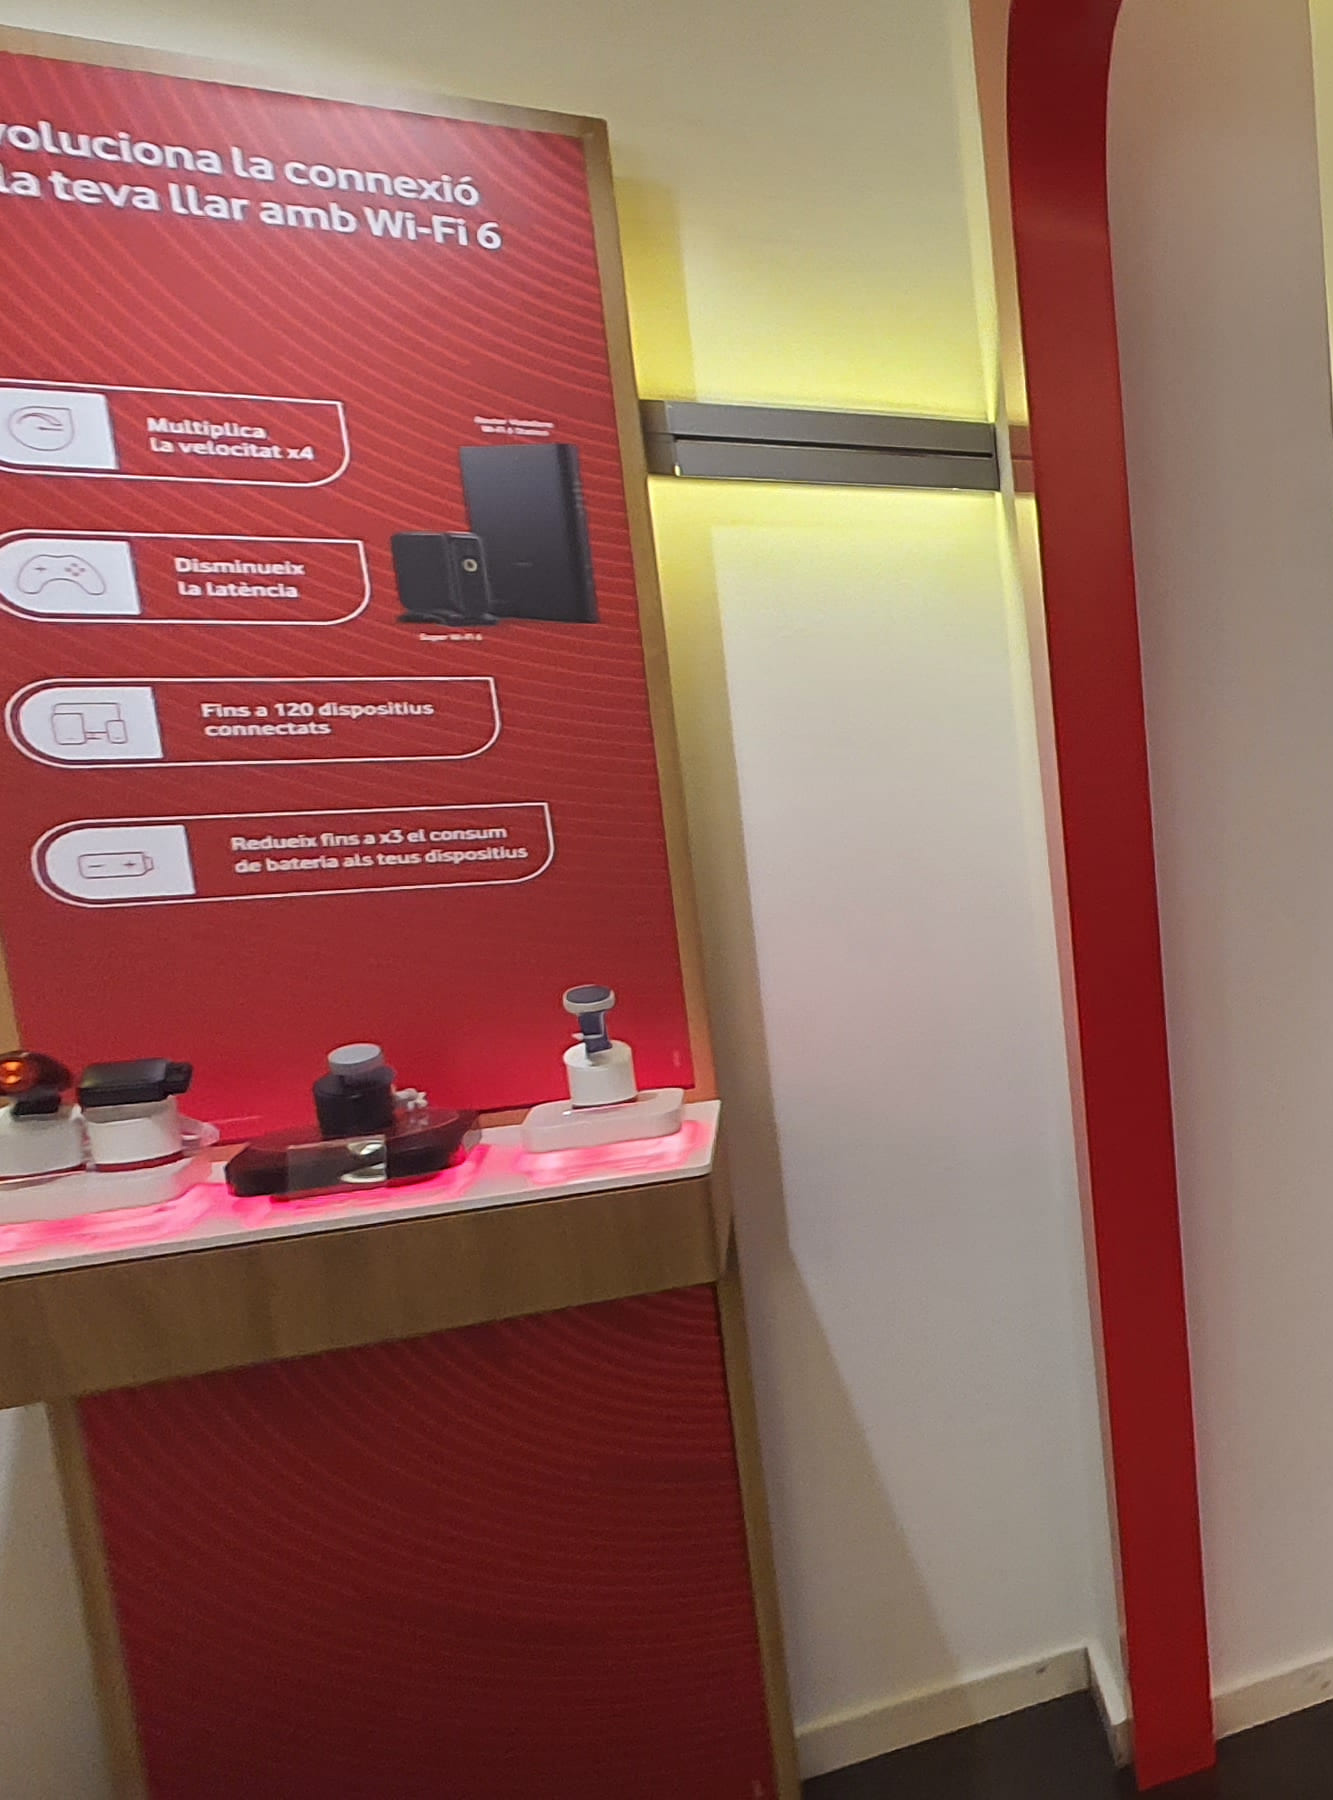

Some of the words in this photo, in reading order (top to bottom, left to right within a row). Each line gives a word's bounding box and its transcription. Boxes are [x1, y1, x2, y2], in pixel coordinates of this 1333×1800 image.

[0, 120, 223, 175] oluciona
[231, 146, 276, 182] la
[283, 160, 481, 207] connexió
[48, 169, 161, 212] teva
[168, 182, 250, 221] llar
[259, 200, 358, 234] amb
[362, 205, 470, 246] Wi-Fi
[476, 221, 502, 250] 6
[146, 416, 269, 440] Multiplica
[150, 436, 175, 453] la
[179, 440, 284, 459] velocitat
[287, 445, 315, 461] x4
[174, 556, 306, 576] Disminueix
[177, 580, 202, 597] la
[206, 581, 300, 598] latència
[201, 702, 252, 719] Fins
[255, 705, 269, 719] a
[274, 702, 315, 718] 120
[317, 701, 435, 720] dispositius
[204, 720, 332, 738] connectats
[230, 834, 318, 852] Redueix
[320, 832, 360, 848] fins
[362, 833, 376, 846] a
[379, 829, 405, 845] x3
[406, 828, 427, 843] el
[429, 827, 508, 843] consum
[234, 858, 263, 875] de
[265, 855, 340, 874] bateria
[342, 852, 375, 869] als
[377, 850, 422, 867] teus
[424, 845, 529, 865] dispositius
